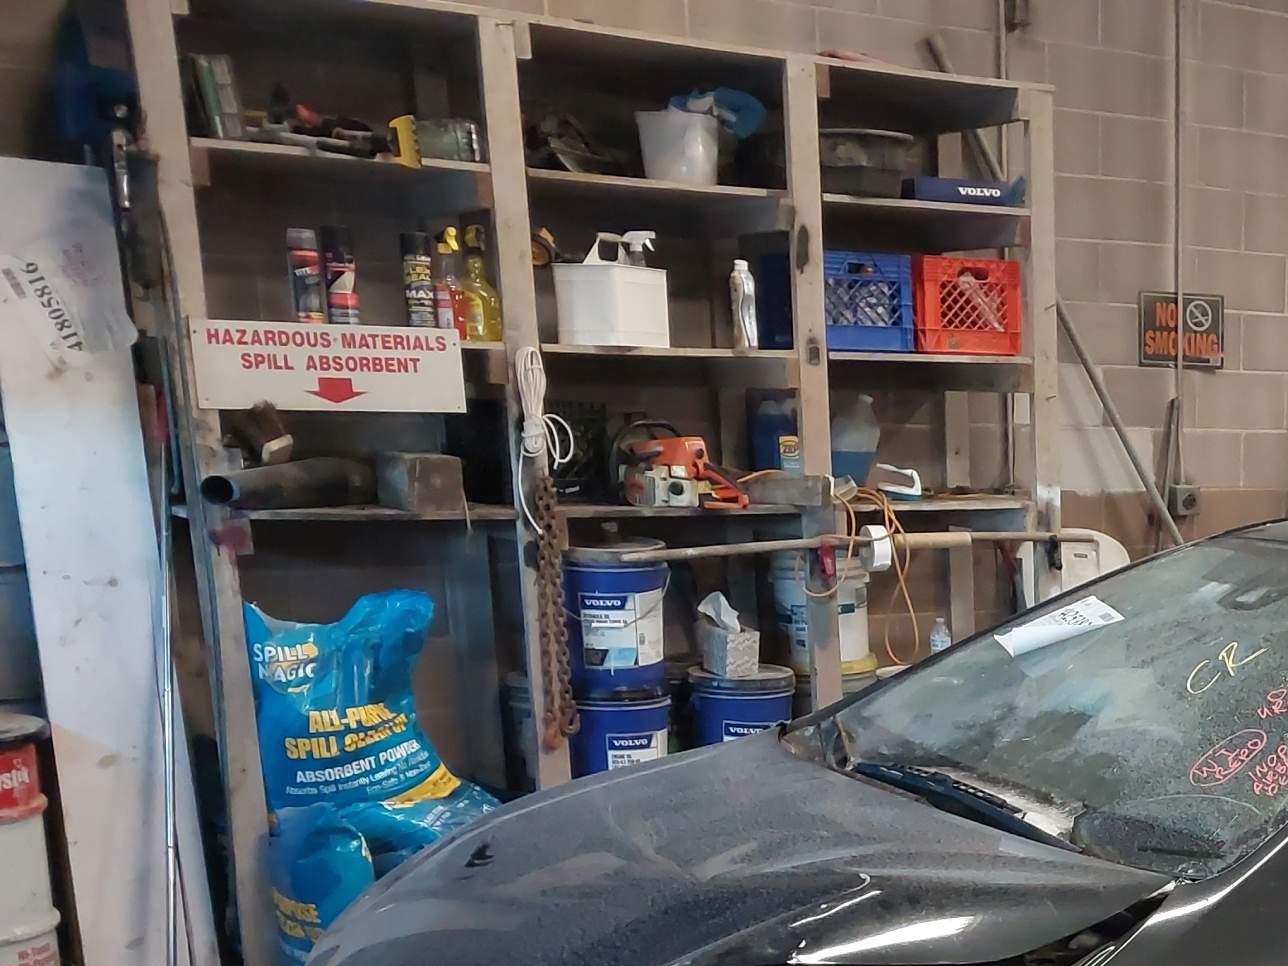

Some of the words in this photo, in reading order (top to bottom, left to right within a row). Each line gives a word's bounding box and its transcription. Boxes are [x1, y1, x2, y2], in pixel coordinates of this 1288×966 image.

[957, 186, 1001, 198] VOLVO
[19, 261, 84, 352] 41805816
[1155, 302, 1178, 328] NO
[206, 328, 332, 348] HAZARDOUS
[341, 332, 448, 352] MATERIALS
[241, 352, 294, 370] SPILL
[306, 355, 420, 373] ABSORBENT
[583, 598, 621, 607] VOLVO
[253, 642, 308, 662] SPILL
[258, 662, 318, 683] MAGIC
[1186, 641, 1271, 695] CR
[727, 726, 763, 735] VOLV
[284, 737, 340, 760] SPILL
[612, 738, 648, 747] VOLVO
[295, 756, 377, 784] ABSORBENT
